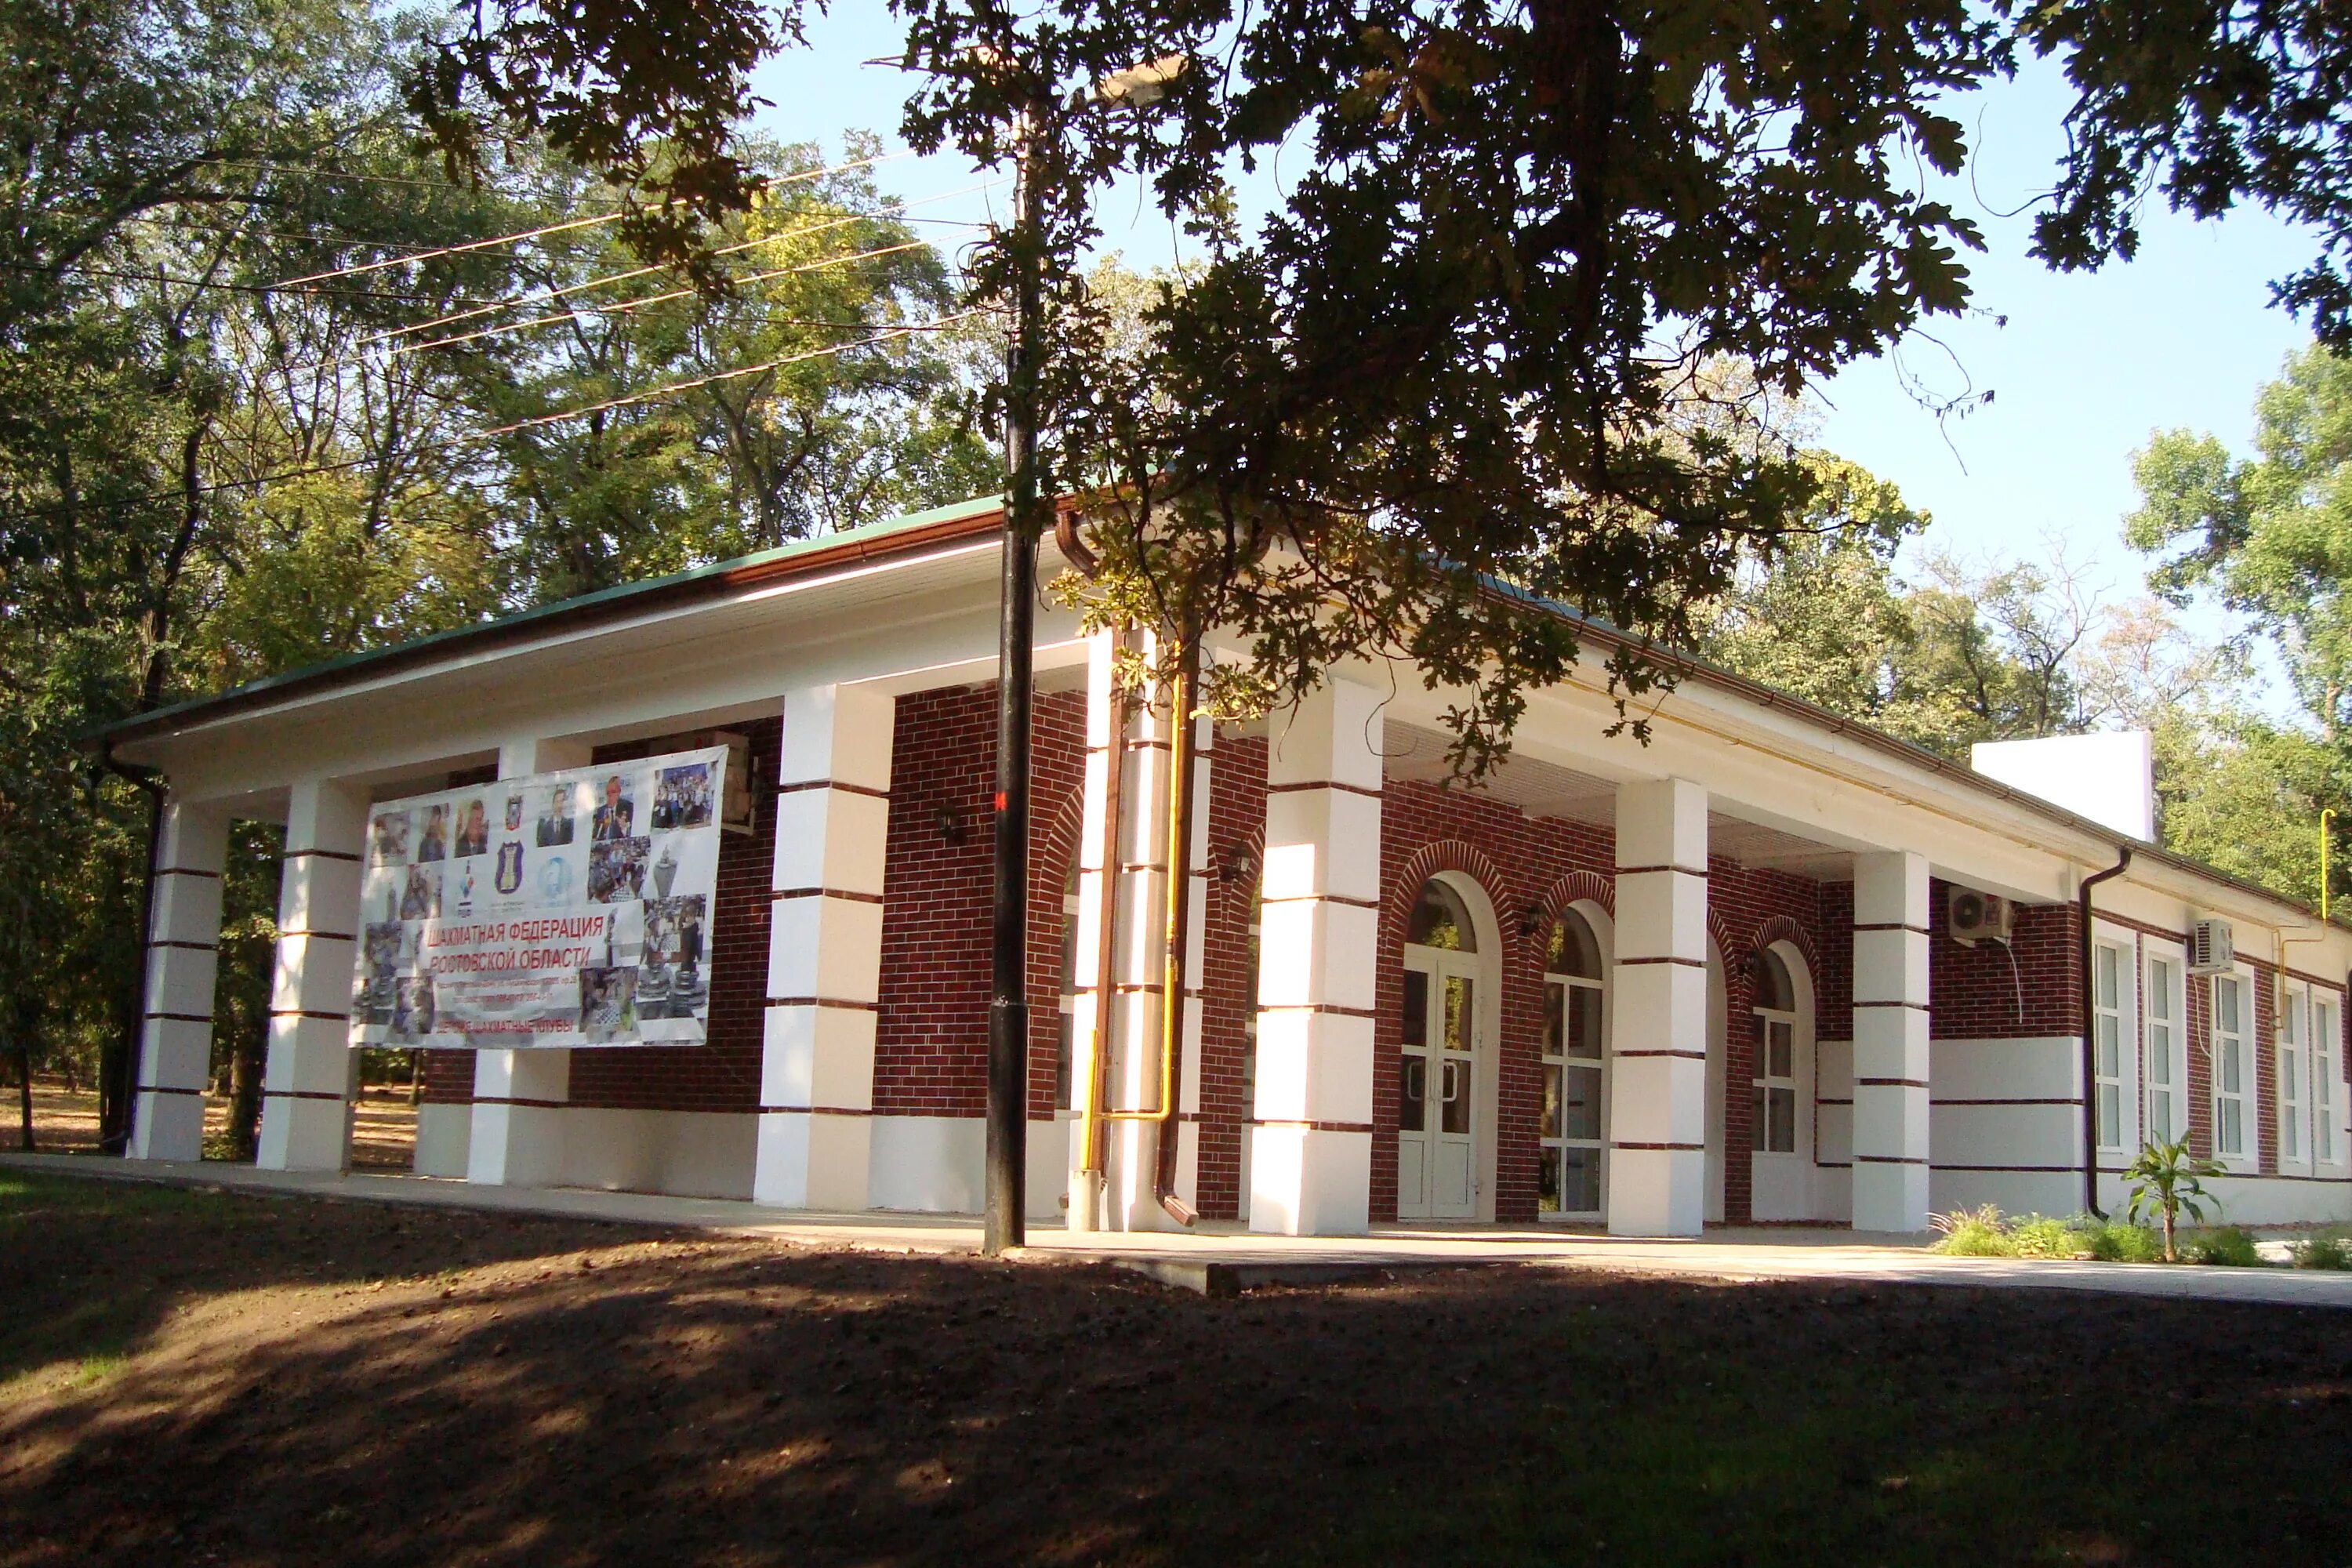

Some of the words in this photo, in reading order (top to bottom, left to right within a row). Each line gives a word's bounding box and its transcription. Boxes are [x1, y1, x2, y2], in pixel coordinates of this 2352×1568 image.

[427, 923, 506, 947] ШАХМАТНАЯ
[510, 916, 604, 943] ФЕДЕРАЦИЯ
[430, 946, 516, 974] РОСТОВСКОЙ
[520, 946, 592, 970] ОБЛАСТИ
